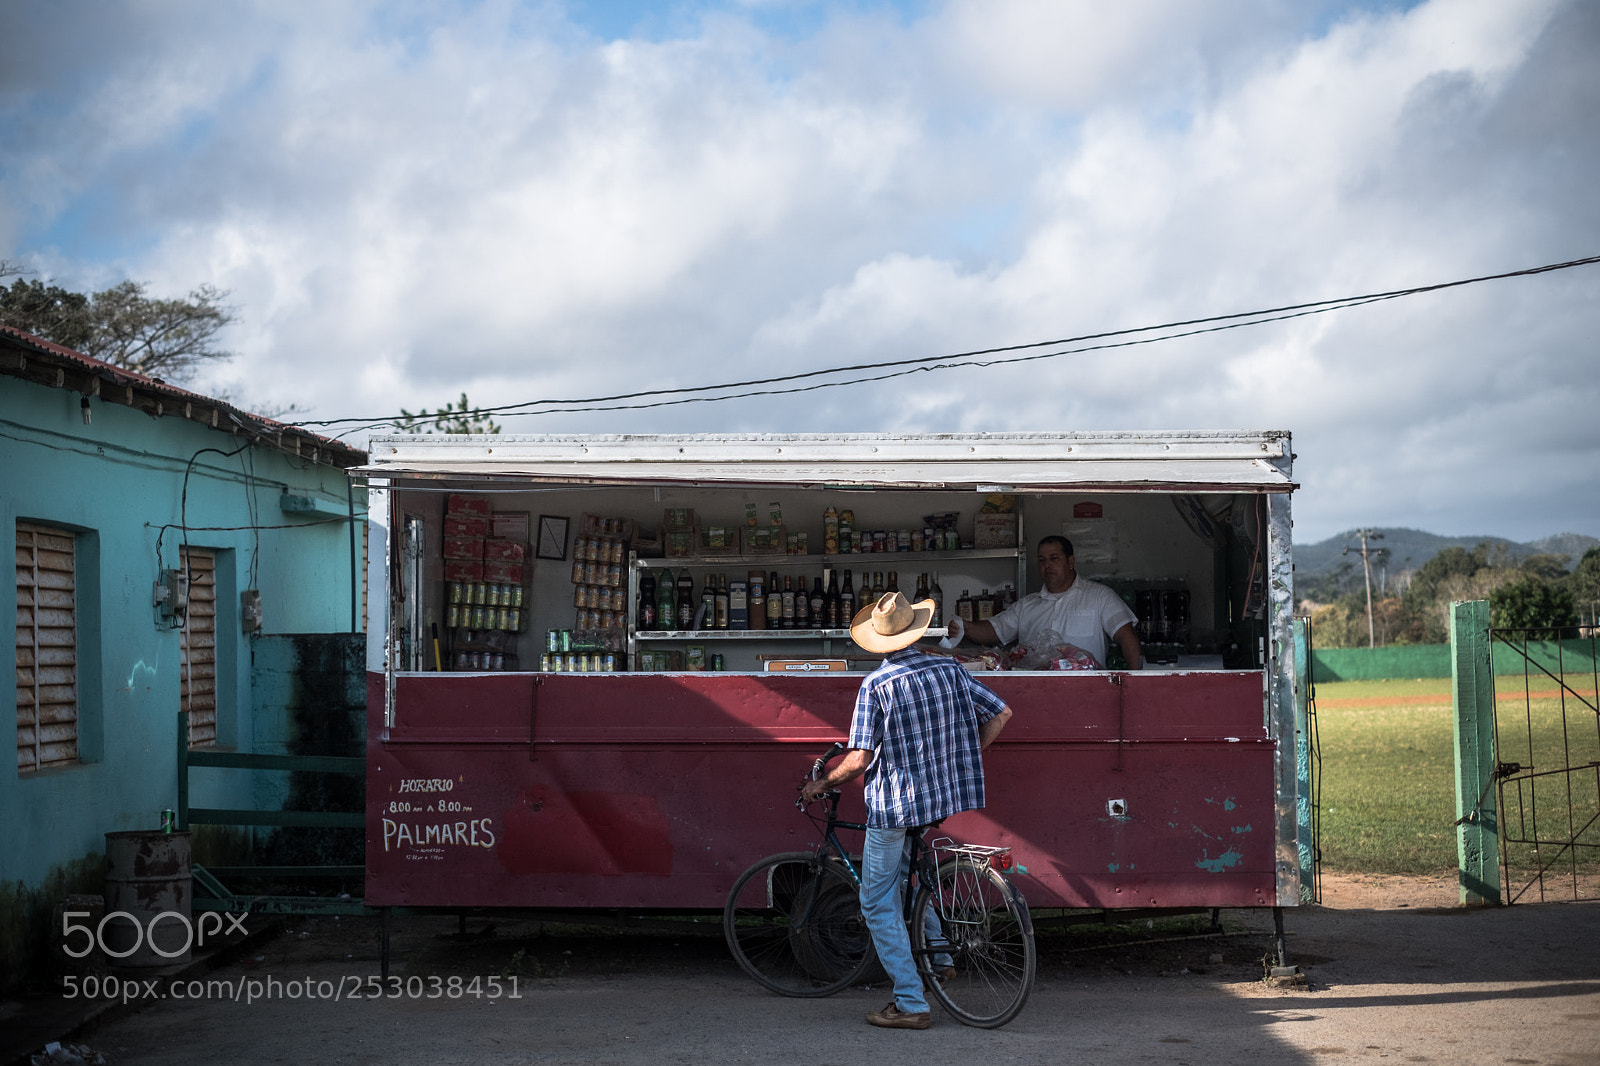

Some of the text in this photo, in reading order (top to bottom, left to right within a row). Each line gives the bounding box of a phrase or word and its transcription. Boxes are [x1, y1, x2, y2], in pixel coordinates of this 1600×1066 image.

[398, 778, 454, 793] HORARIO
[438, 799, 461, 813] 8.00
[382, 818, 496, 852] PALMARES
